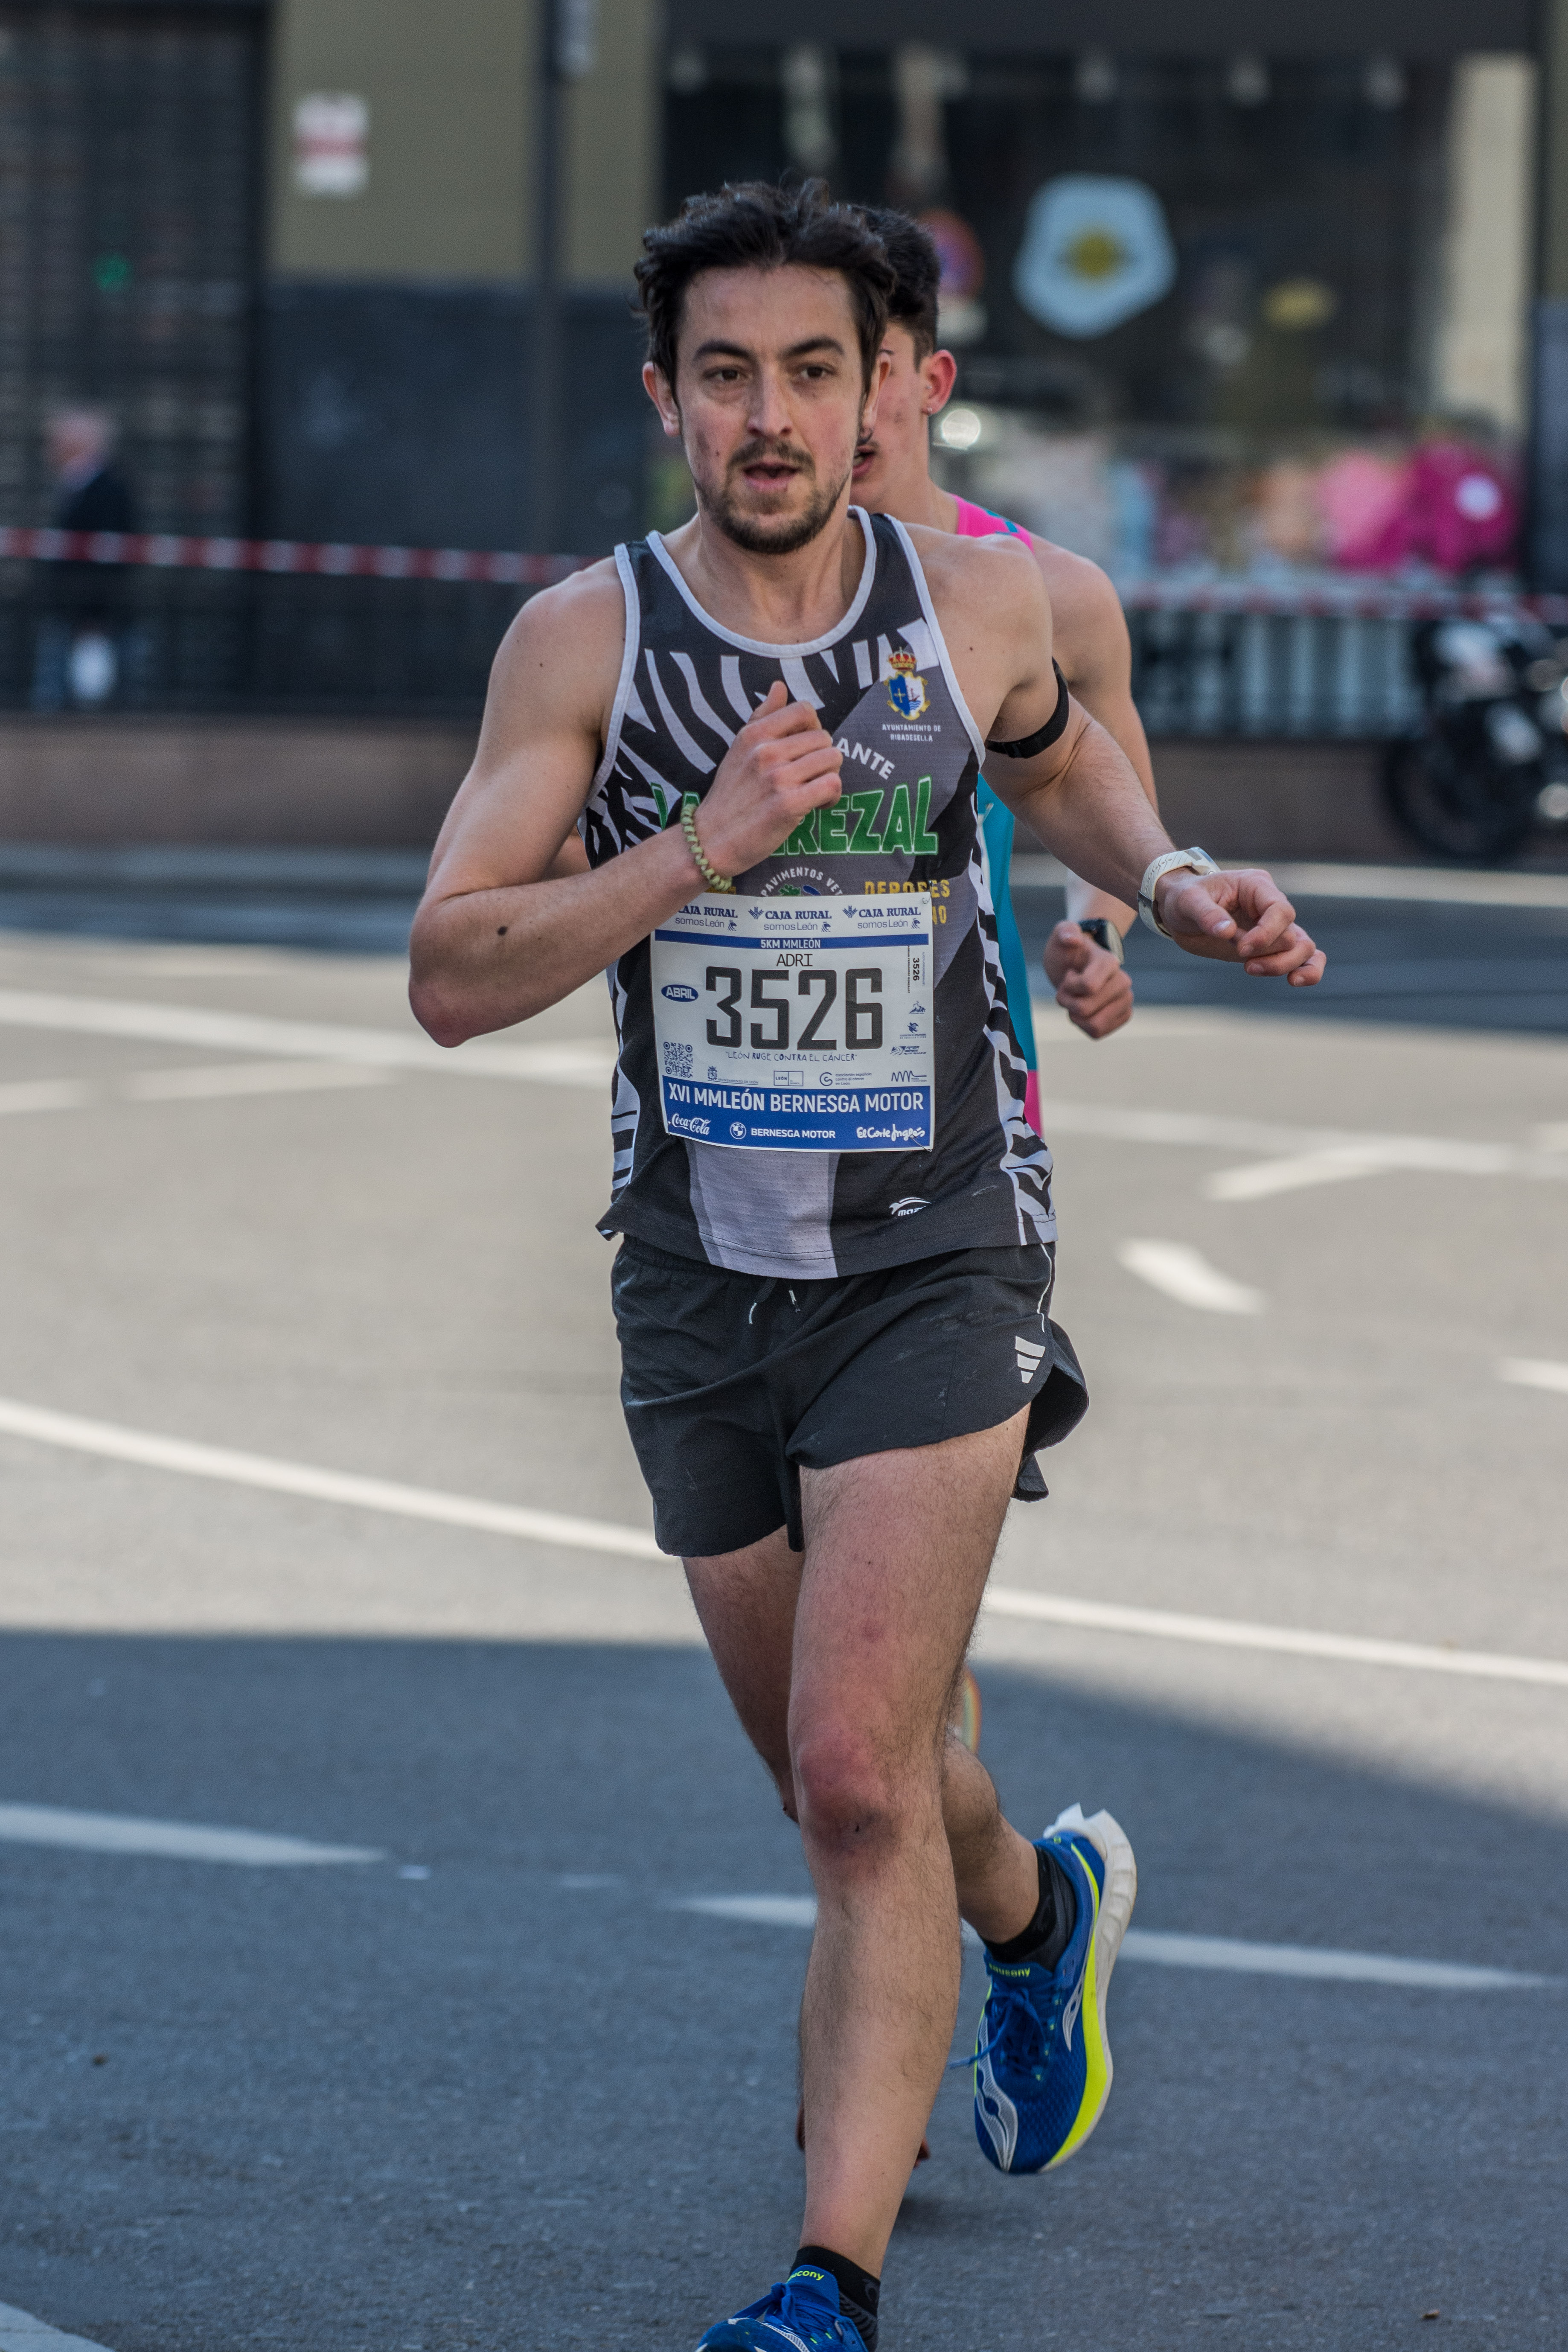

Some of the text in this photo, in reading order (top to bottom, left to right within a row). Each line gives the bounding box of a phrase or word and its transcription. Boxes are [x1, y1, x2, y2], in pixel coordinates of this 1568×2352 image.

[882, 724, 931, 732] AYUNTAMIENTO
[890, 733, 933, 742] RIBADESELLA
[832, 737, 896, 780] ANTE
[771, 774, 938, 856] REZAL
[761, 867, 843, 897] PAVIMENTOS VET
[678, 905, 738, 918] AJA RURAL
[765, 910, 832, 920] CAJA RURAL
[858, 909, 884, 918] CAJA
[886, 907, 921, 917] RURAL
[760, 937, 821, 949] 5KM MMLEÓN
[776, 954, 813, 967] ADRI
[666, 987, 695, 1000] ABRIL
[706, 966, 883, 1051] 3526
[752, 1052, 771, 1061] RUGE
[774, 1053, 807, 1061] CONTRA
[809, 1054, 820, 1062] EL
[668, 1083, 924, 1113] XVI MMLEÓN BERNESGA MOTOR
[751, 1128, 836, 1138] BERNESGA MOTOR
[856, 1127, 867, 1138] El
[867, 1127, 891, 1138] Corte
[786, 2270, 825, 2281] ucony
